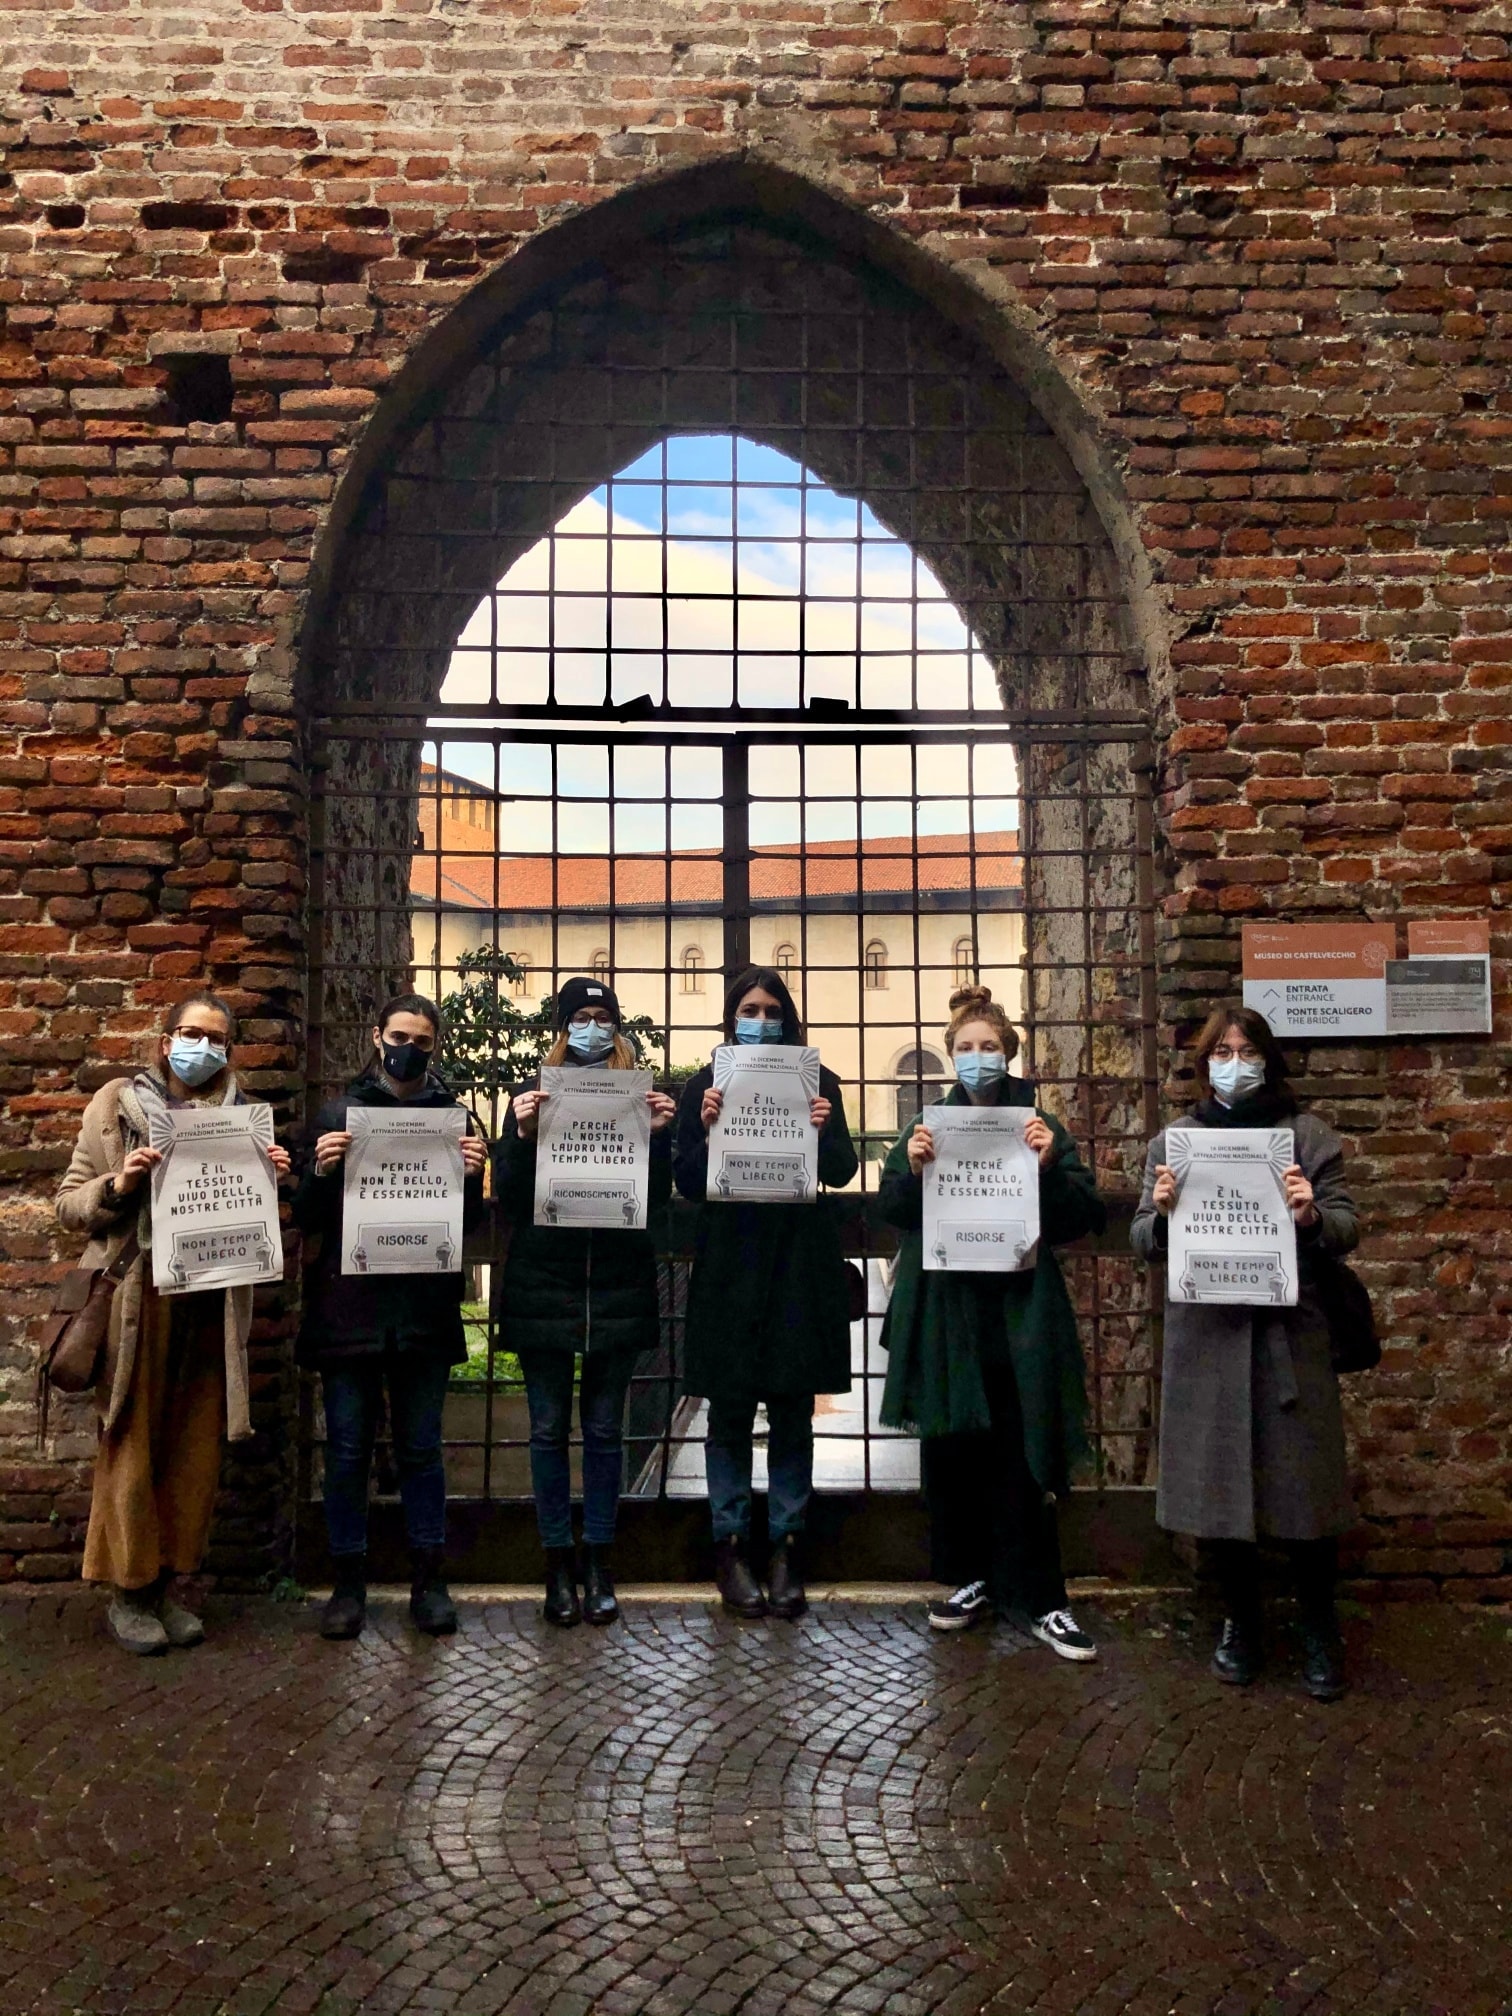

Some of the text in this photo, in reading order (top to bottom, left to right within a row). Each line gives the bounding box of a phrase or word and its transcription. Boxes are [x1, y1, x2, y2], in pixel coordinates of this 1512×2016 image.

[1286, 985, 1328, 993] ENTRATA
[1286, 993, 1335, 1001] ENTRANCE
[1286, 1007, 1373, 1016] PONTE SCALIGERO
[1306, 1016, 1340, 1024] BRIDGE
[754, 1093, 775, 1105] È IL
[740, 1106, 789, 1116] TESSUTO
[202, 1121, 232, 1129] DICEMBRE
[572, 1119, 617, 1130] PERCHÉ
[762, 1118, 797, 1128] DELLE
[176, 1126, 249, 1138] ATTIVAZIONE NAZIONALE
[563, 1132, 624, 1141] IL NOSTRO
[724, 1128, 804, 1139] NOSTRE CITTÀ
[601, 1144, 622, 1153] NON
[629, 1142, 635, 1153] È
[381, 1160, 428, 1171] PERCHÉ
[552, 1155, 634, 1165] TEMPO LIBERO
[729, 1160, 750, 1168] NON
[766, 1162, 799, 1170] TEMPO
[957, 1158, 1003, 1170] PERCHÉ
[201, 1162, 227, 1175] È IL
[187, 1175, 243, 1189] TESSUTO
[361, 1173, 448, 1186] NON È BELLO,
[743, 1171, 785, 1182] LIBERO
[939, 1171, 1022, 1184] NON È BELLO,
[213, 1186, 253, 1198] DELLE
[360, 1187, 448, 1199] È ESSENZIALE
[554, 1190, 629, 1199] RICONOSCIMENTO
[938, 1184, 1023, 1197] È ESSENZIALE
[1217, 1185, 1242, 1199] È IL
[171, 1193, 262, 1216] NOSTRE CITTÀ
[1202, 1200, 1259, 1210] TESSUTO
[1228, 1213, 1269, 1223] DELLE
[1185, 1223, 1278, 1236] NOSTRE CITTÀ
[182, 1240, 206, 1250] NON
[222, 1232, 261, 1245] TEMPO
[377, 1235, 429, 1246] RISORSE
[956, 1232, 1005, 1242] RISORSE
[198, 1247, 247, 1262] LIBERO
[1194, 1261, 1218, 1269] NON
[1235, 1262, 1274, 1271] TEMPO
[1210, 1273, 1259, 1284] LIBERO
